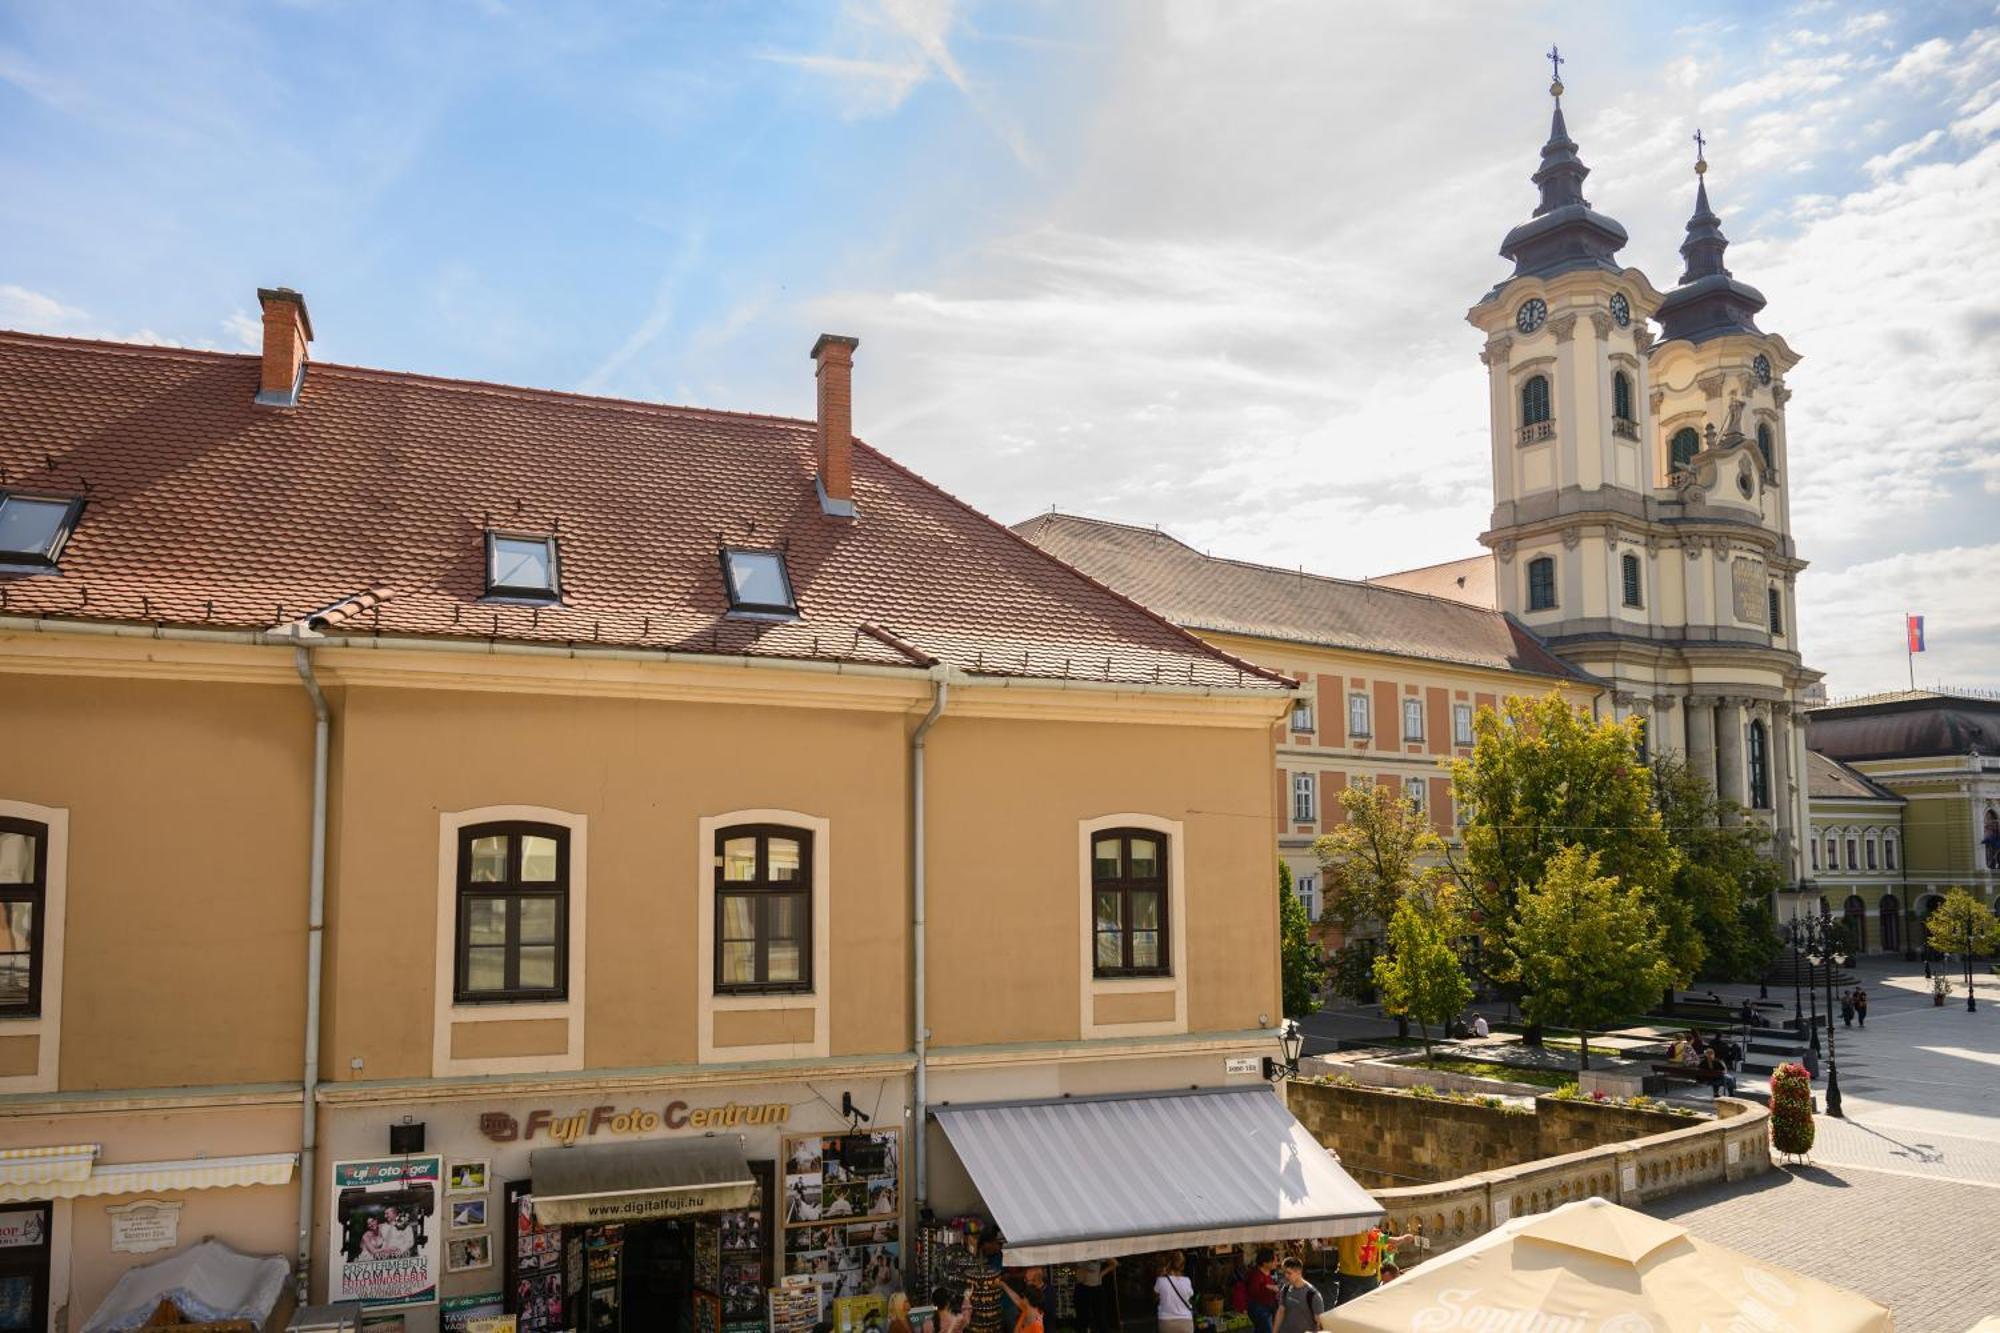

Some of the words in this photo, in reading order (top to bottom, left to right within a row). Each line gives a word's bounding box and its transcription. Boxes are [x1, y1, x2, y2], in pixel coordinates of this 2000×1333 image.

[525, 1109, 588, 1143] Fuji
[588, 1106, 658, 1136] Foto
[664, 1101, 790, 1129] Centrum
[588, 1197, 704, 1215] www.digitalfuji.hu
